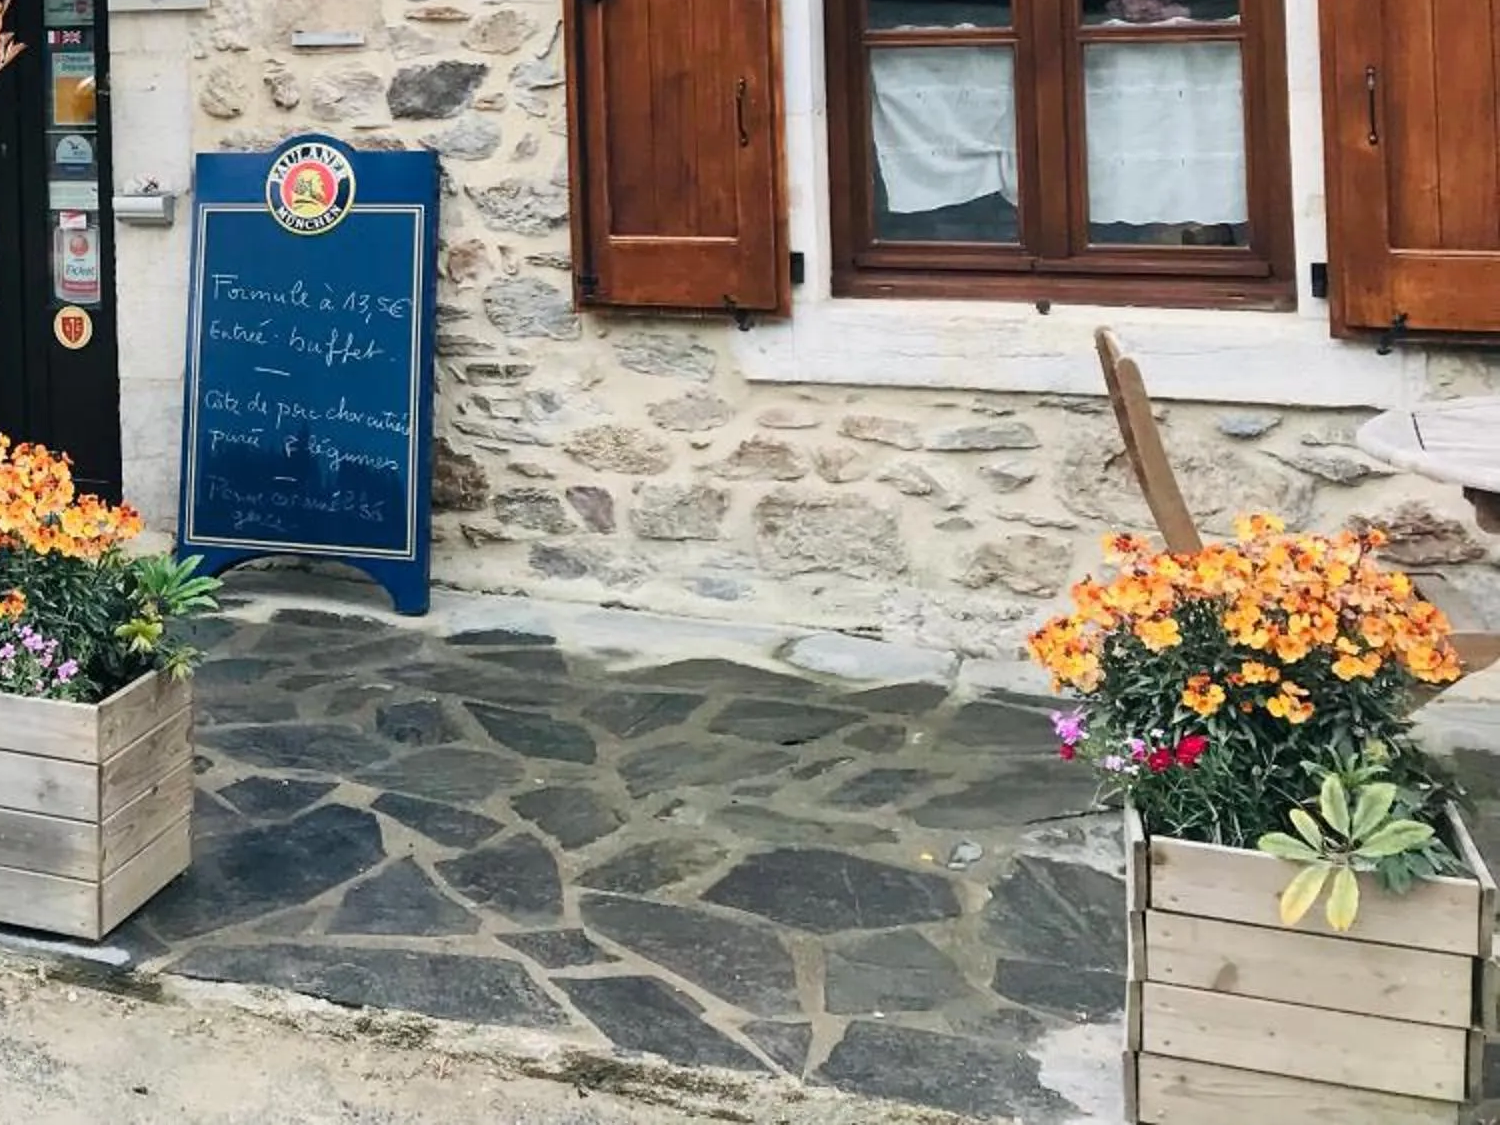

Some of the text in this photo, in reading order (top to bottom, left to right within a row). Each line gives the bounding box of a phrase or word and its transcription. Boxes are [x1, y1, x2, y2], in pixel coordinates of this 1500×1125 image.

[212, 274, 310, 308] Formule
[319, 282, 334, 311] à
[307, 435, 399, 471] légumes
